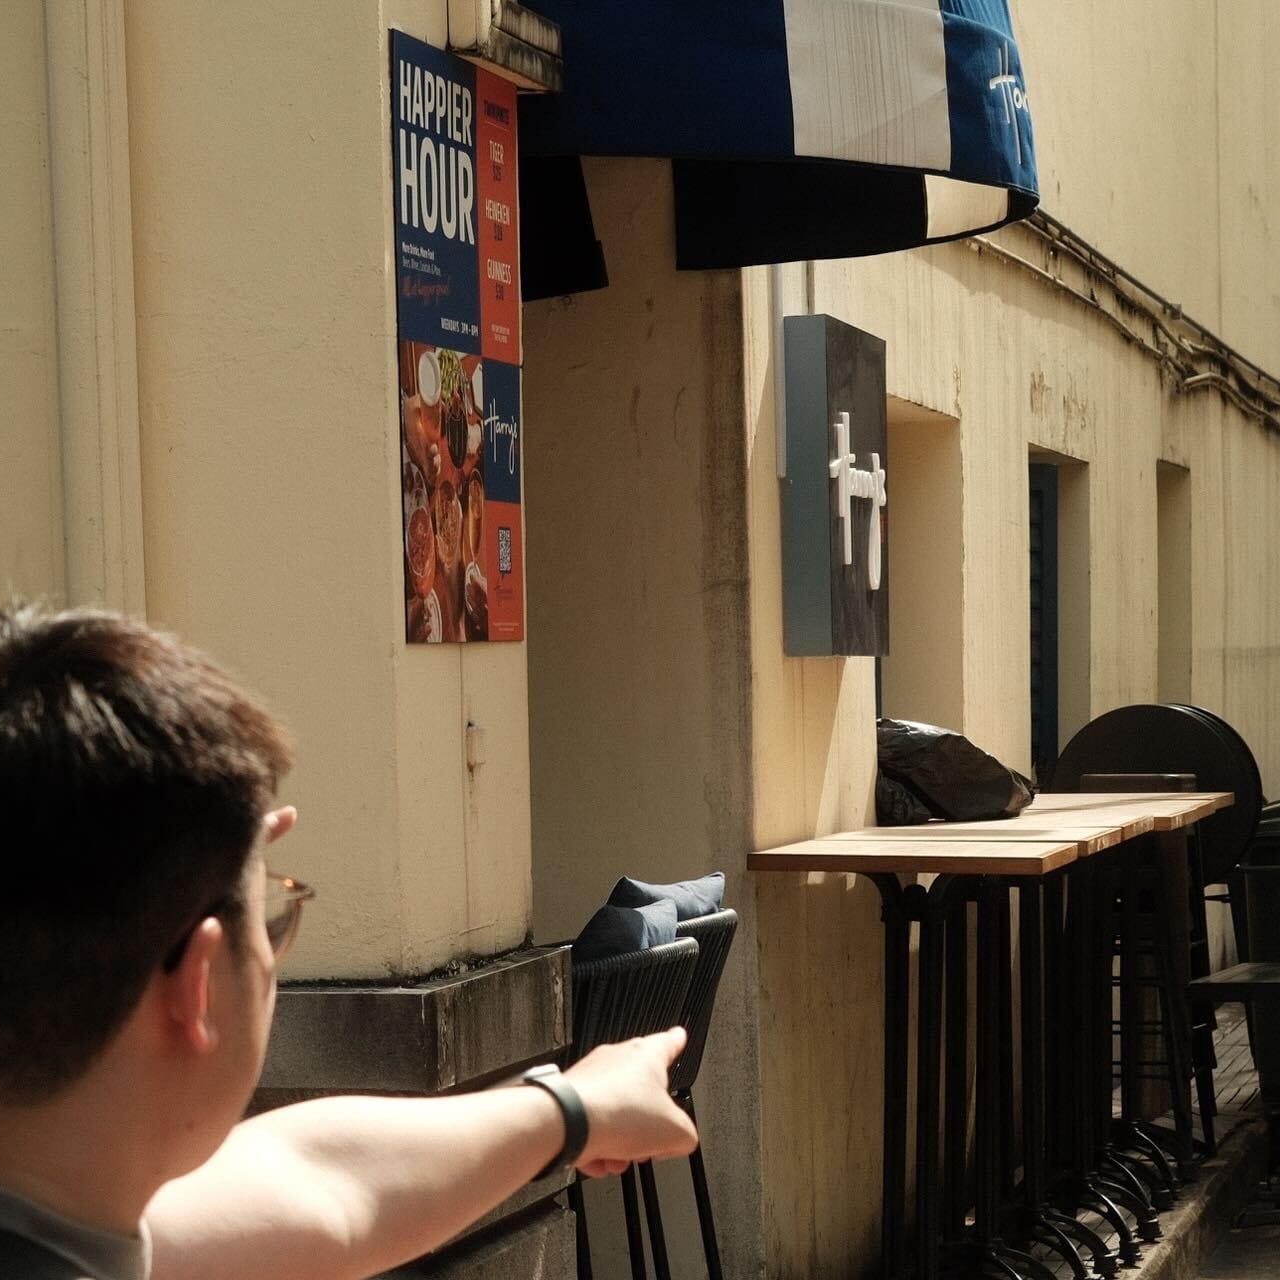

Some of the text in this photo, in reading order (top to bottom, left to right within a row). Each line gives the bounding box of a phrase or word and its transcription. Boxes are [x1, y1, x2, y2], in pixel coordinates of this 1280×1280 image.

[399, 59, 473, 147] HAPPIER
[489, 140, 505, 165] TIGER
[399, 129, 475, 245] HOUR
[485, 198, 510, 226] HEINEKEN
[487, 258, 512, 285] GUINNESS
[483, 398, 518, 475] Harry's
